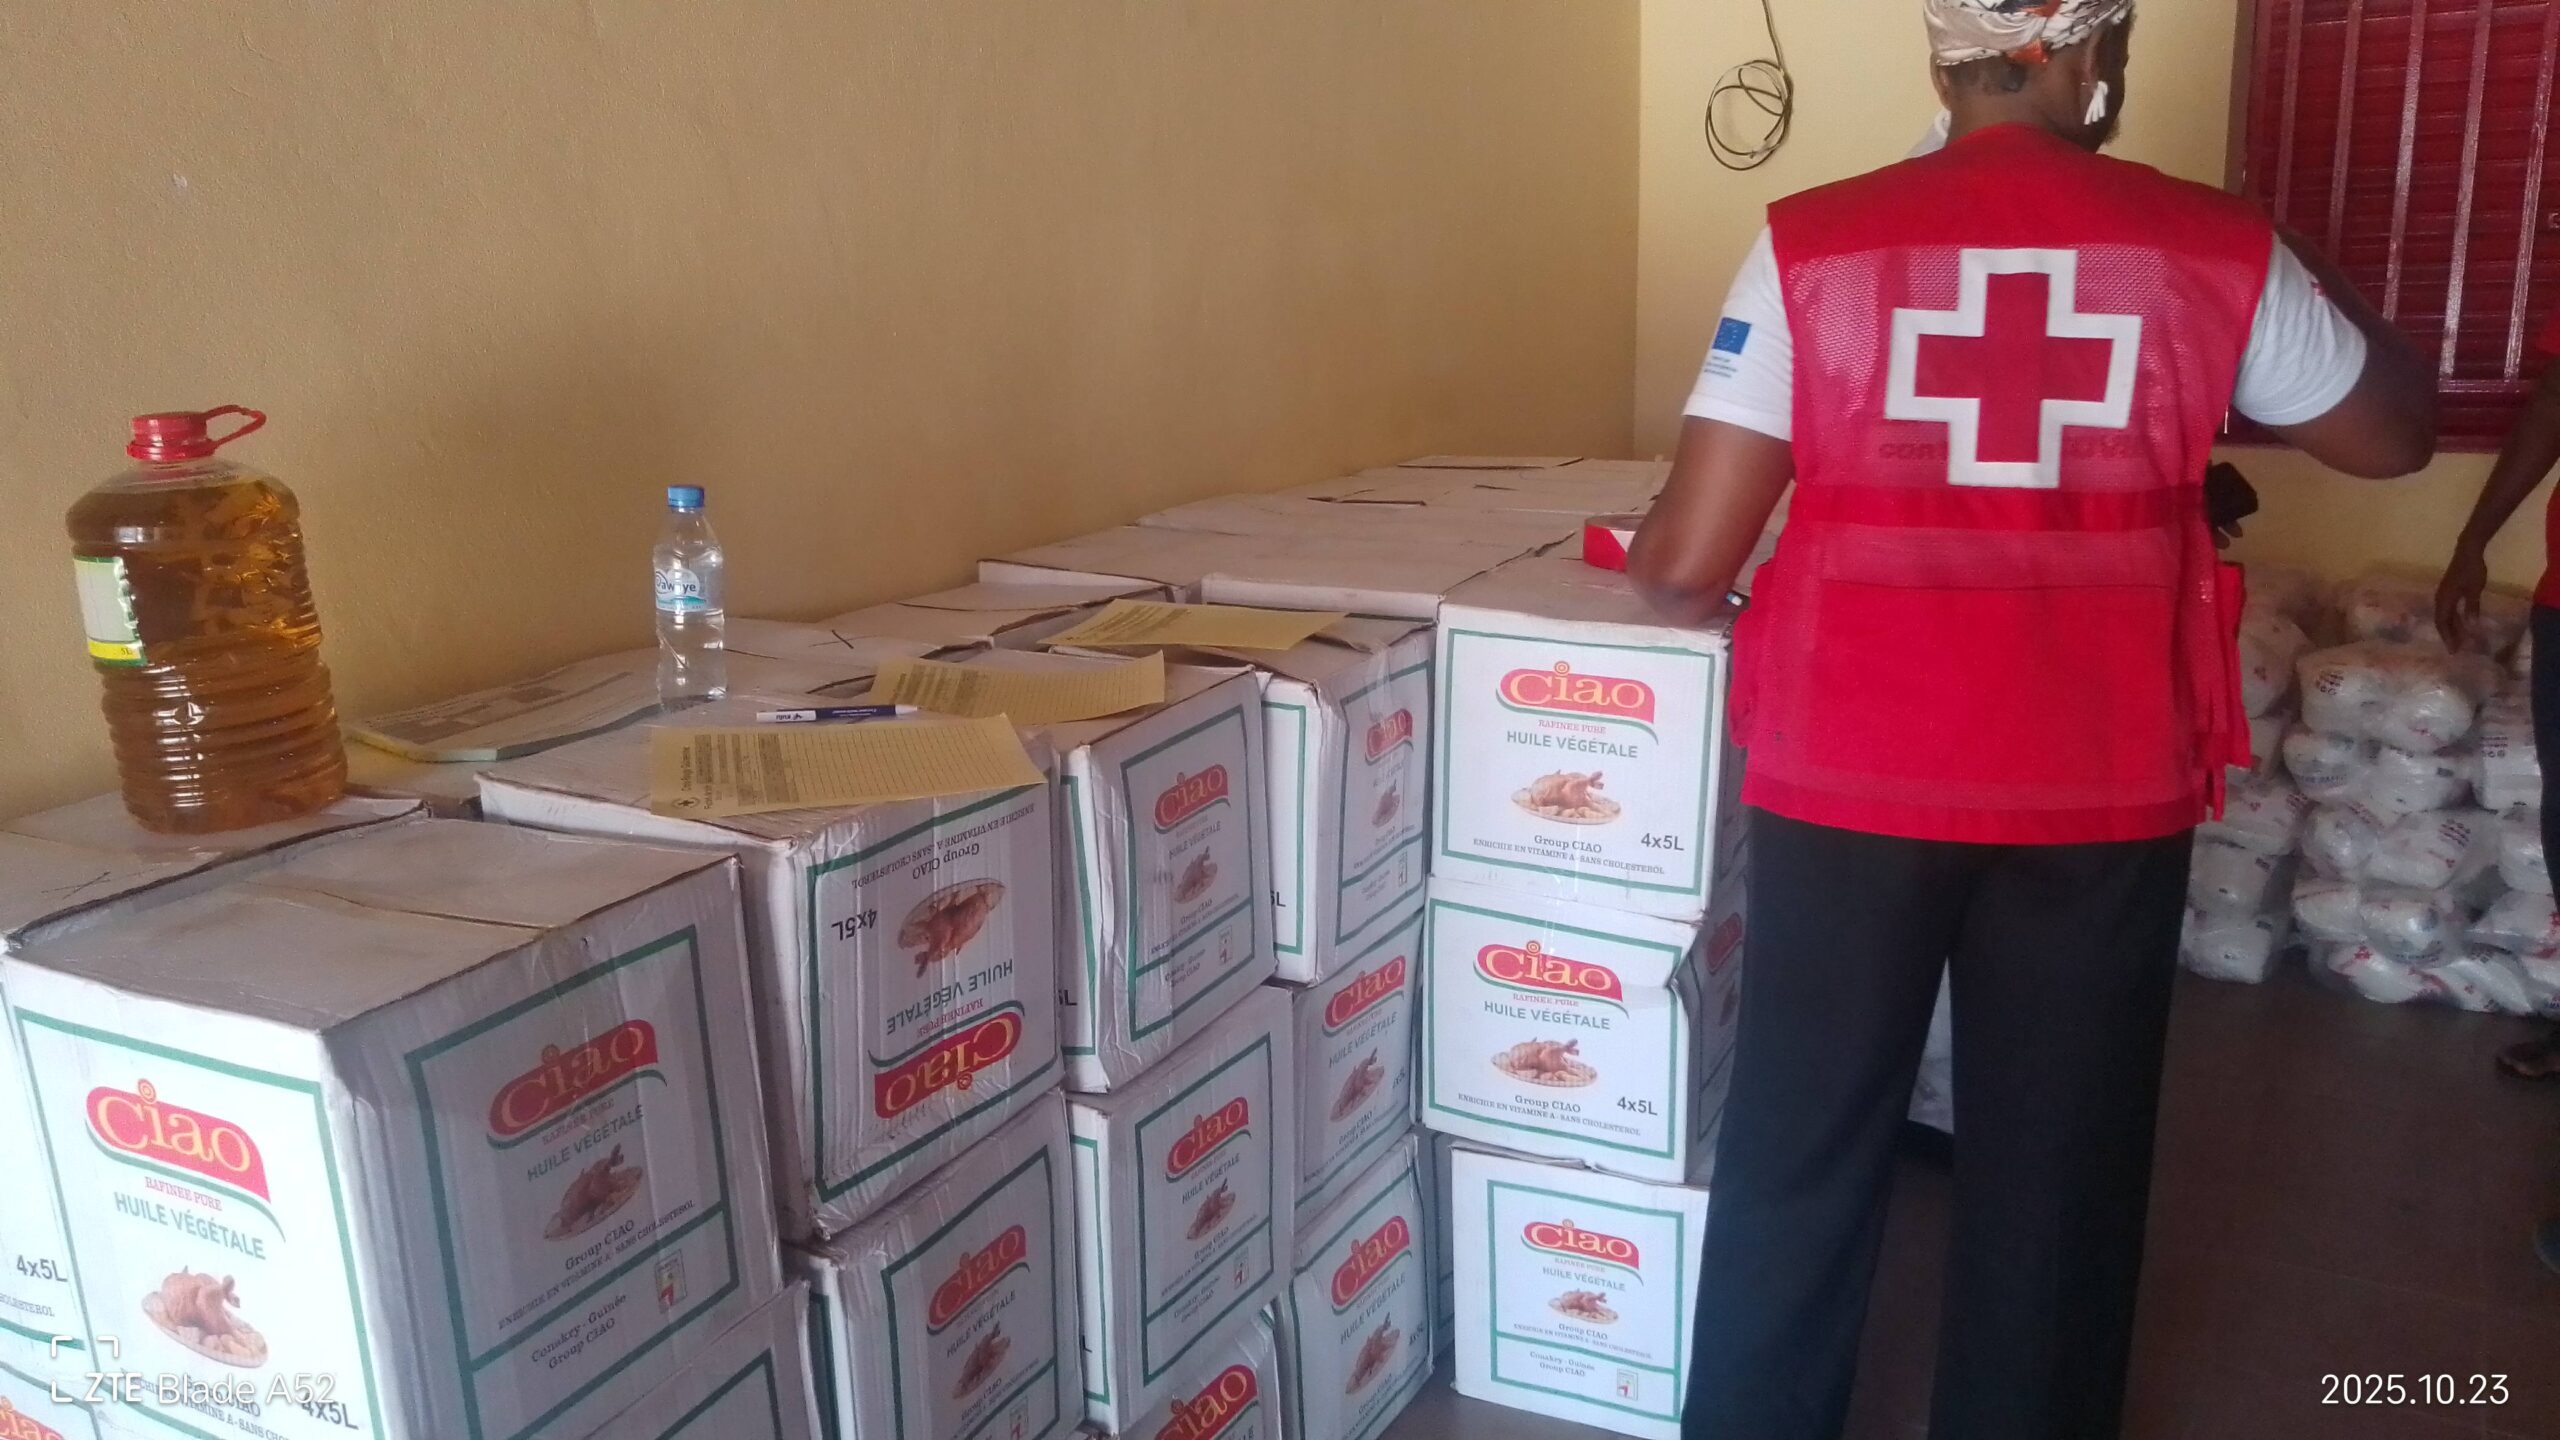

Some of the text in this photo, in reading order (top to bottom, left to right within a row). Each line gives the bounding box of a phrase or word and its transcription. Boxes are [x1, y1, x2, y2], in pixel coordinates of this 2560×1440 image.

[1510, 660, 1645, 708] Ciao
[1506, 730, 1638, 758] HUILE VÉGÉTALE
[1581, 722, 1607, 735] PURE
[1160, 768, 1223, 823] Ciao
[1514, 843, 1527, 854] EN
[1534, 834, 1602, 854] Group CIAO
[1640, 833, 1685, 851] 4x5L
[912, 843, 980, 880] Group CIAO
[831, 908, 878, 941] 4x5L
[1486, 940, 1612, 991] Ciao
[885, 958, 1013, 1036] HUILE VÉGÉTALE
[1332, 959, 1402, 1023] Ciao
[1484, 1001, 1610, 1030] HUILE VÉGÉTALE
[502, 1028, 644, 1128] Ciao
[885, 1016, 1015, 1113] Ciao
[1515, 1095, 1581, 1113] Group CIAO
[1617, 1096, 1658, 1116] 4x5L
[97, 1078, 251, 1173] Ciao
[1173, 1102, 1243, 1168] Ciao
[527, 1147, 571, 1182] HUILE
[145, 1176, 223, 1212] RAFINEE PURE
[114, 1191, 267, 1260] HUILE VÉGÉTALE
[565, 1219, 635, 1270] Group CIAO
[1531, 1218, 1632, 1258] Ciao
[16, 1254, 69, 1283] 4x5L
[936, 1230, 1019, 1319] Ciao
[1337, 1219, 1403, 1301] Ciao
[1543, 1266, 1572, 1280] HUILE
[548, 1318, 616, 1369] Group CIAO
[1586, 1329, 1608, 1340] CIAO
[1565, 1367, 1586, 1377] CIAO
[300, 1391, 360, 1430] 4x5L
